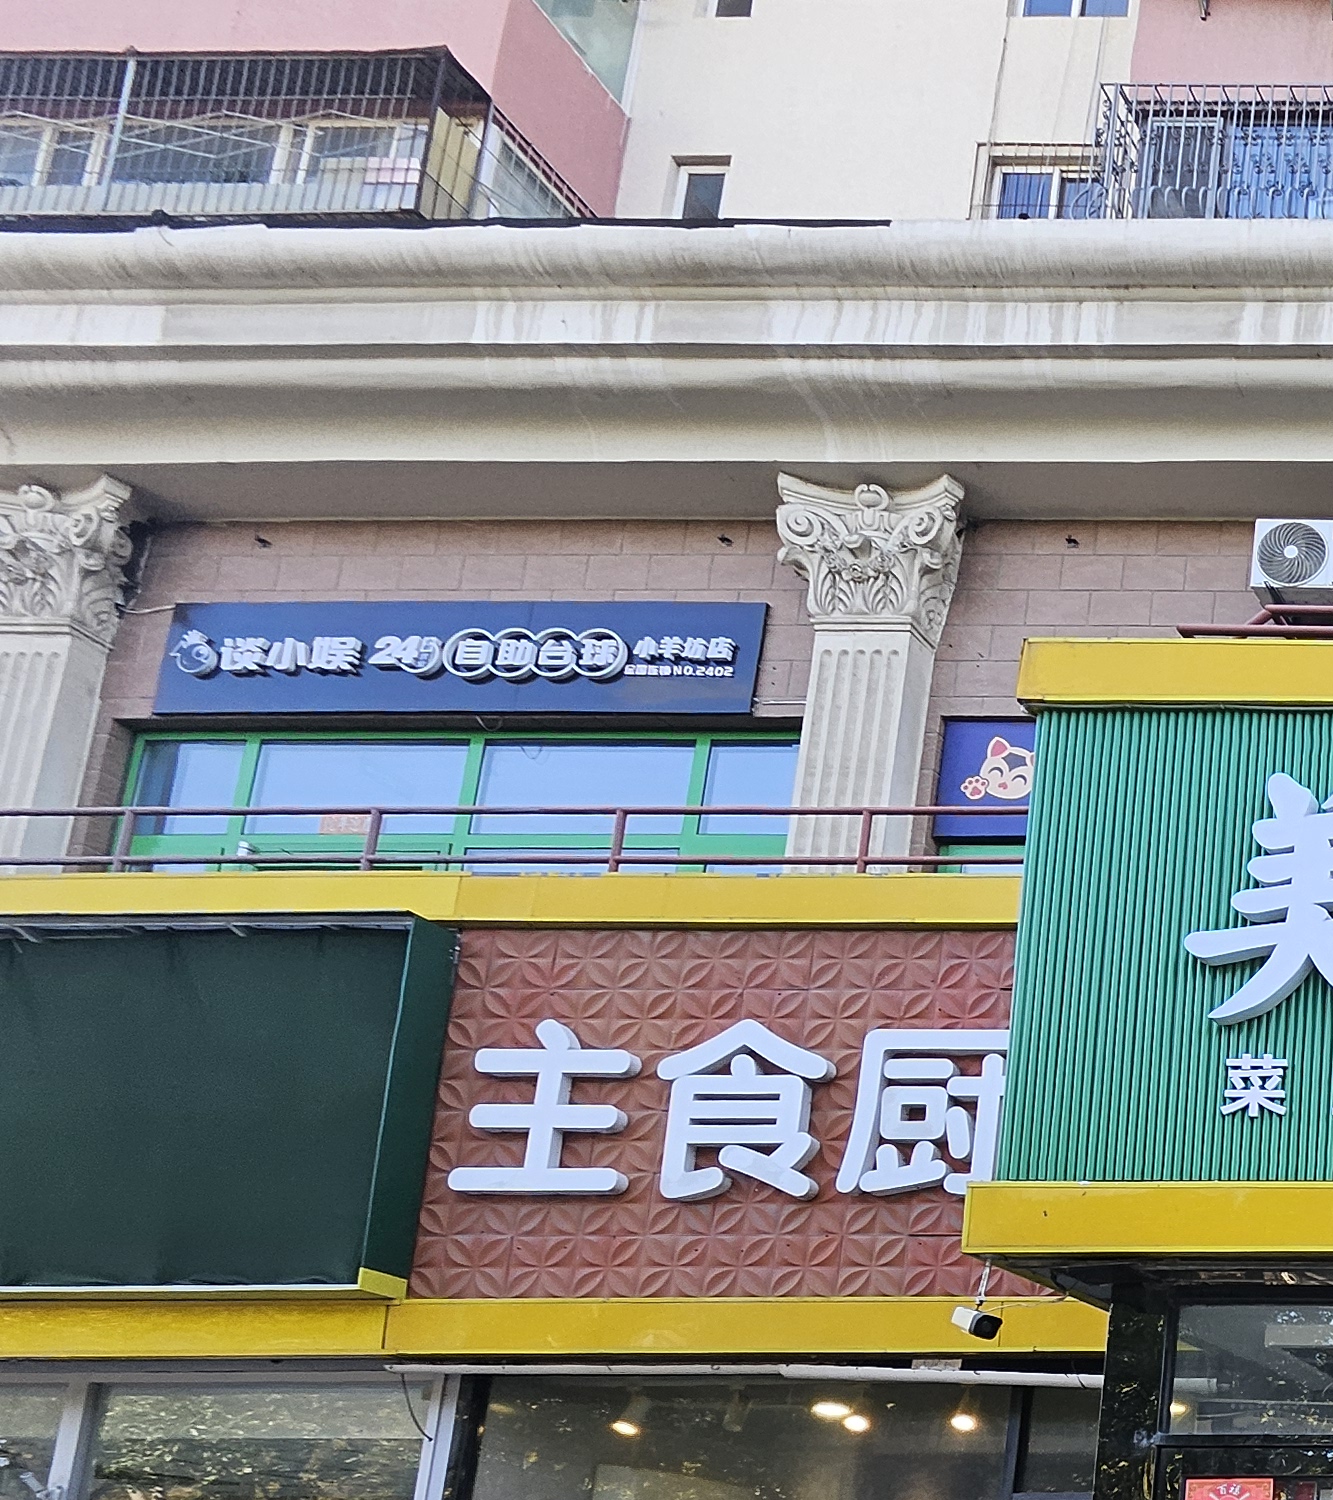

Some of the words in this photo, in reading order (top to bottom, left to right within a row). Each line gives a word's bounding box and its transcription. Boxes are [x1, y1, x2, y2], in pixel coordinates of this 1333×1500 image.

[220, 636, 358, 672] 谈小娱
[454, 637, 618, 666] 自助台球
[447, 1018, 1009, 1201] 主食厨
